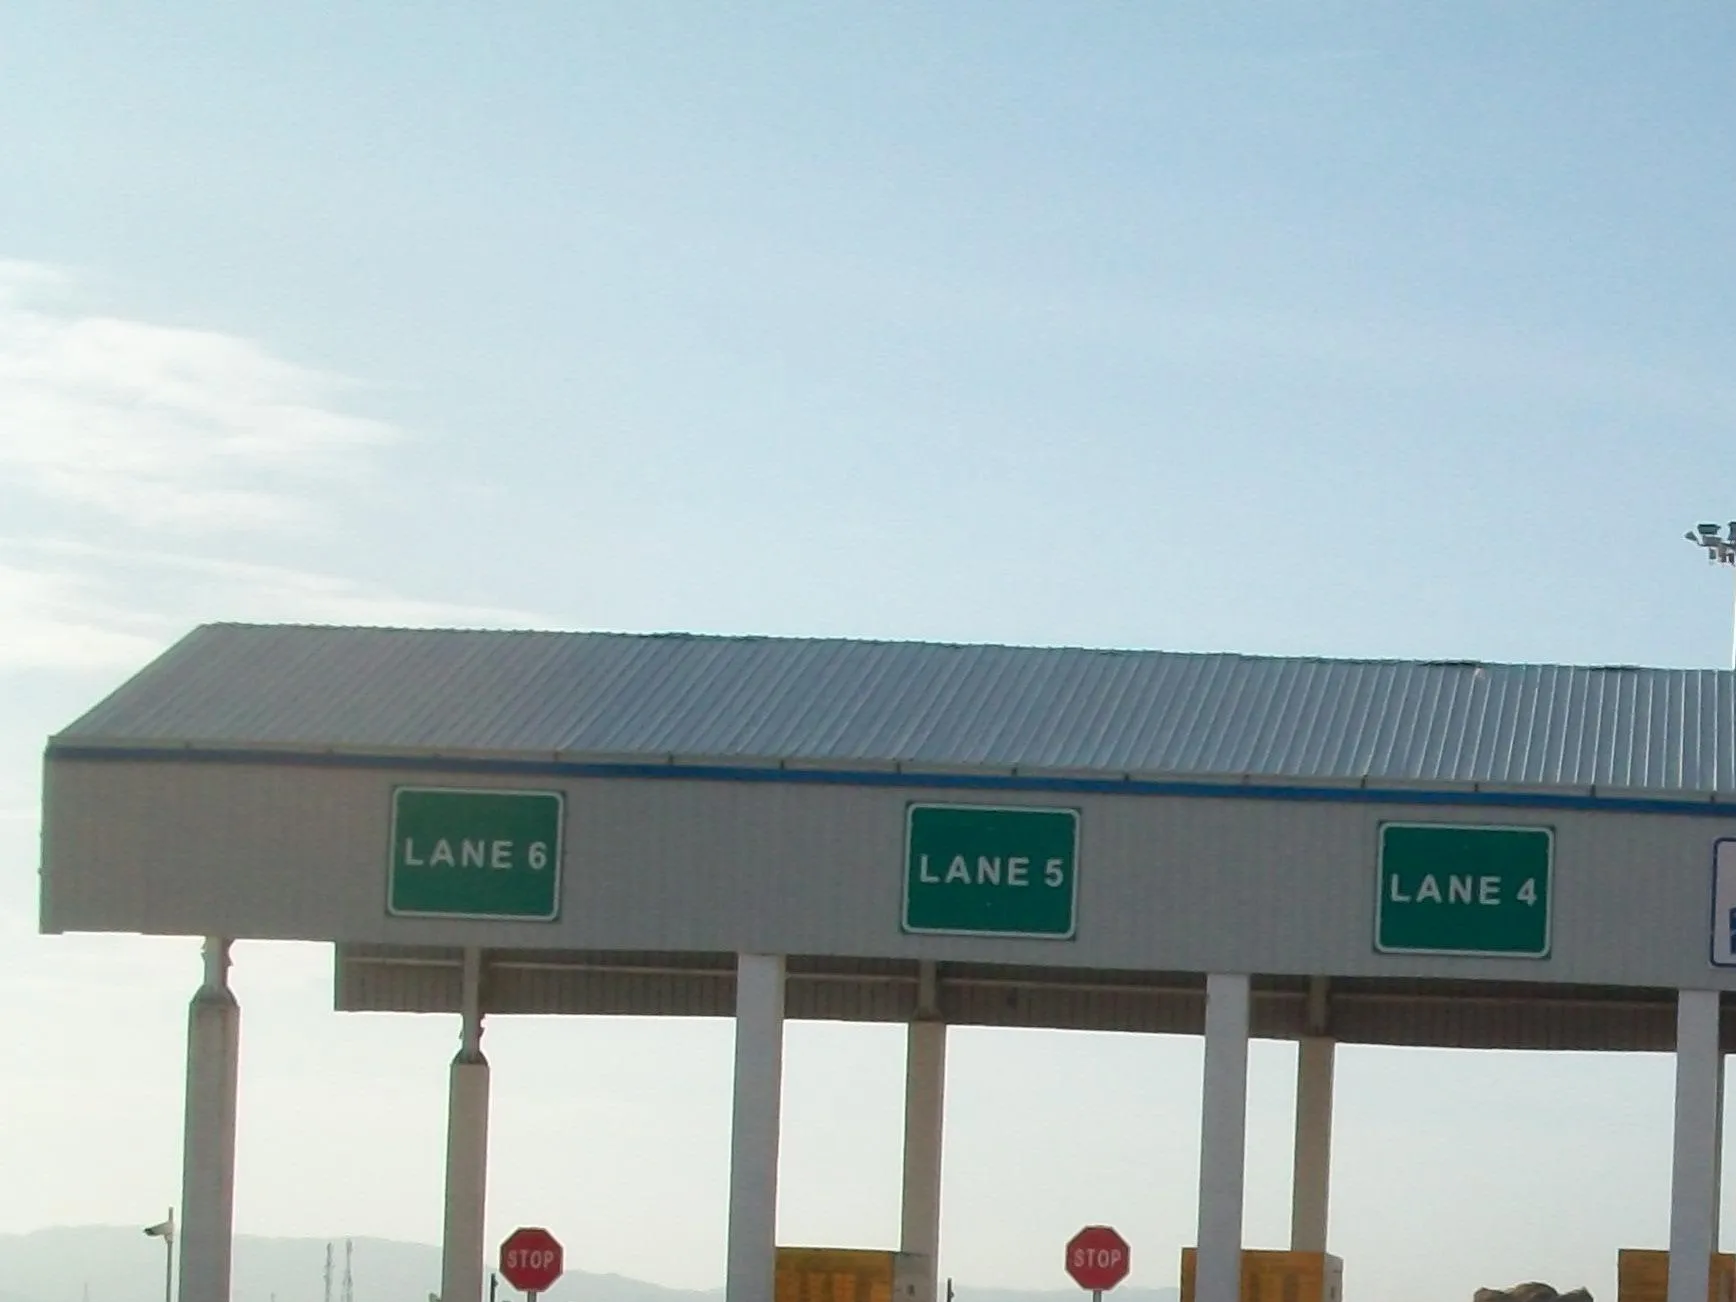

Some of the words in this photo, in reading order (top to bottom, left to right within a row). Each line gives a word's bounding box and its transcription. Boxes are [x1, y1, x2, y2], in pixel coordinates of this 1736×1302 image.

[403, 838, 513, 869] LANE
[527, 841, 547, 870] 6
[919, 854, 1030, 887] LANE
[1043, 858, 1064, 888] 5
[1391, 873, 1501, 905] LANE
[1516, 877, 1538, 907] 4
[507, 1249, 554, 1270] STOP
[1074, 1248, 1121, 1268] STOP
